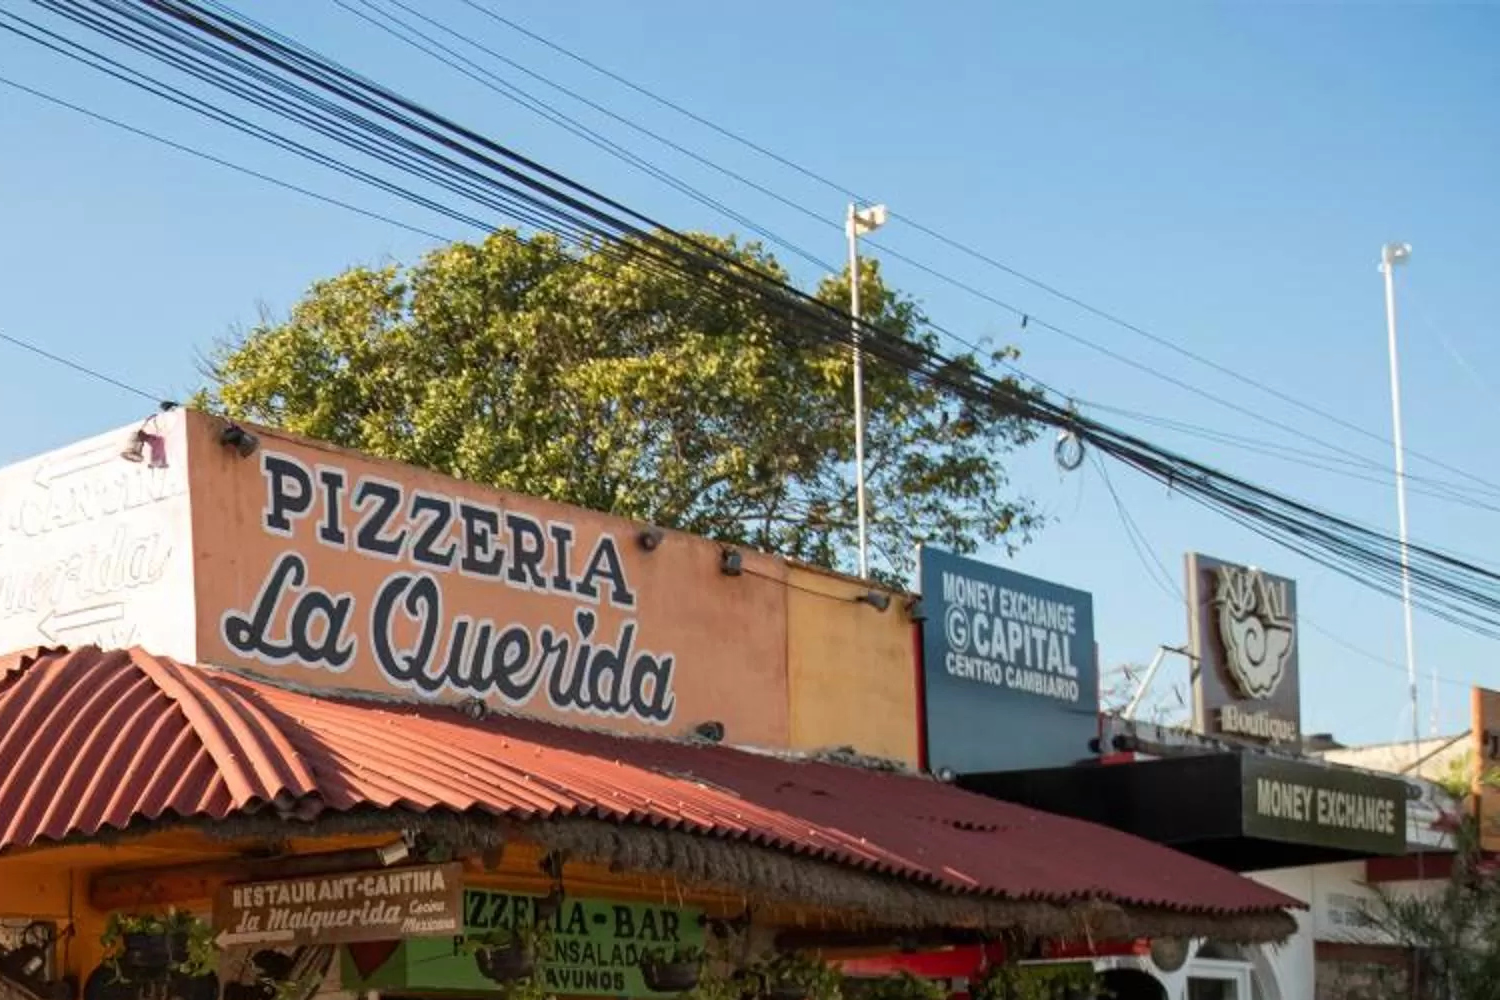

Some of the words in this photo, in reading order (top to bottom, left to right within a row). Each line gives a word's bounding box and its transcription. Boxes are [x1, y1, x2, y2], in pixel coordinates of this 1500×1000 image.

[263, 454, 635, 605] PIZZERIA
[942, 571, 996, 614] MONEY
[999, 586, 1076, 635] EXCHANGE
[223, 553, 355, 668] La
[371, 573, 675, 723] Querida
[973, 612, 1079, 678] CAPITAL
[945, 652, 1003, 686] CENTRO
[1005, 665, 1079, 703] CAMBIARIO
[1221, 704, 1297, 744] Boutique
[1256, 777, 1313, 822] MONEY
[1317, 788, 1396, 835] EXCHANGE
[267, 900, 402, 937] Maiquerida
[463, 889, 589, 935] IZZEIA
[546, 967, 625, 991] AYUNOS
